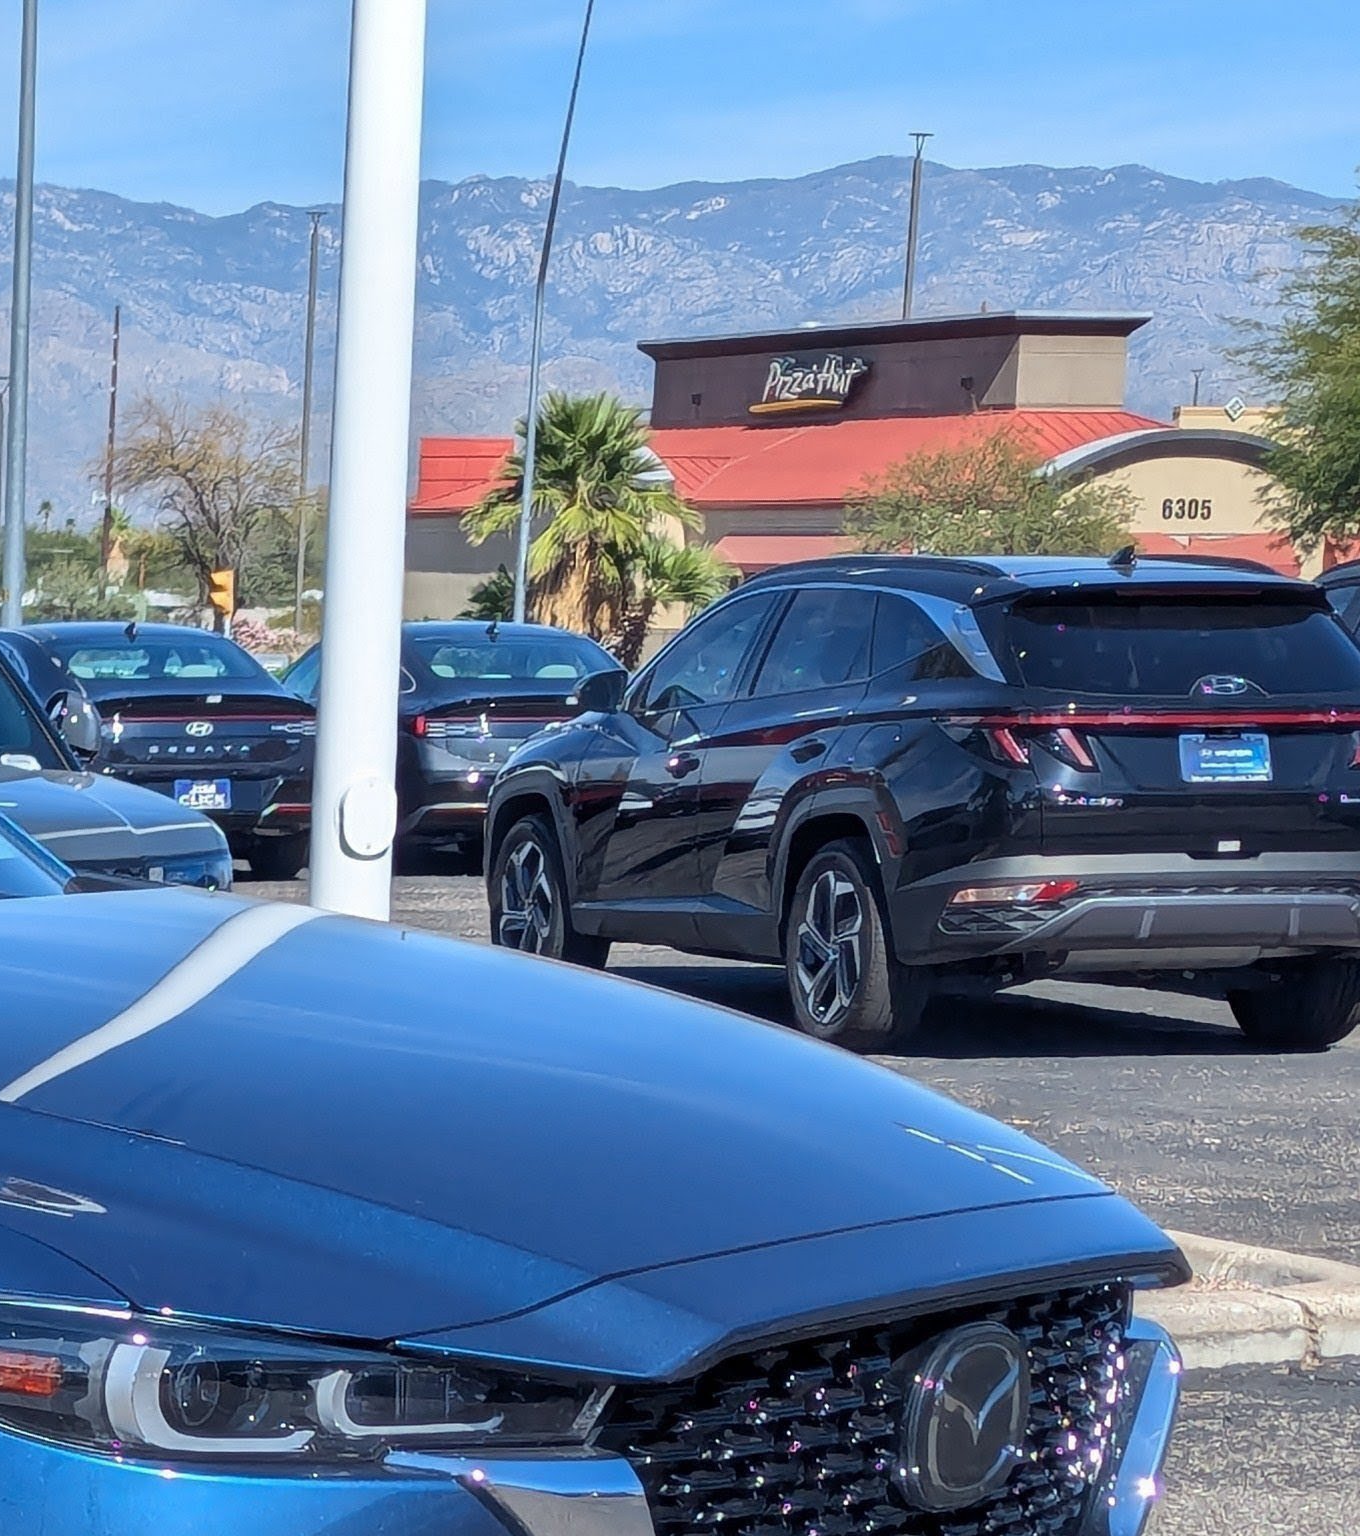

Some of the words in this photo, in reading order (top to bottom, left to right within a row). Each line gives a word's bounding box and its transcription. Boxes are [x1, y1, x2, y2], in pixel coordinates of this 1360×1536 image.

[761, 360, 815, 402] Pizza
[815, 356, 861, 395] Hut
[1161, 498, 1212, 520] 6305
